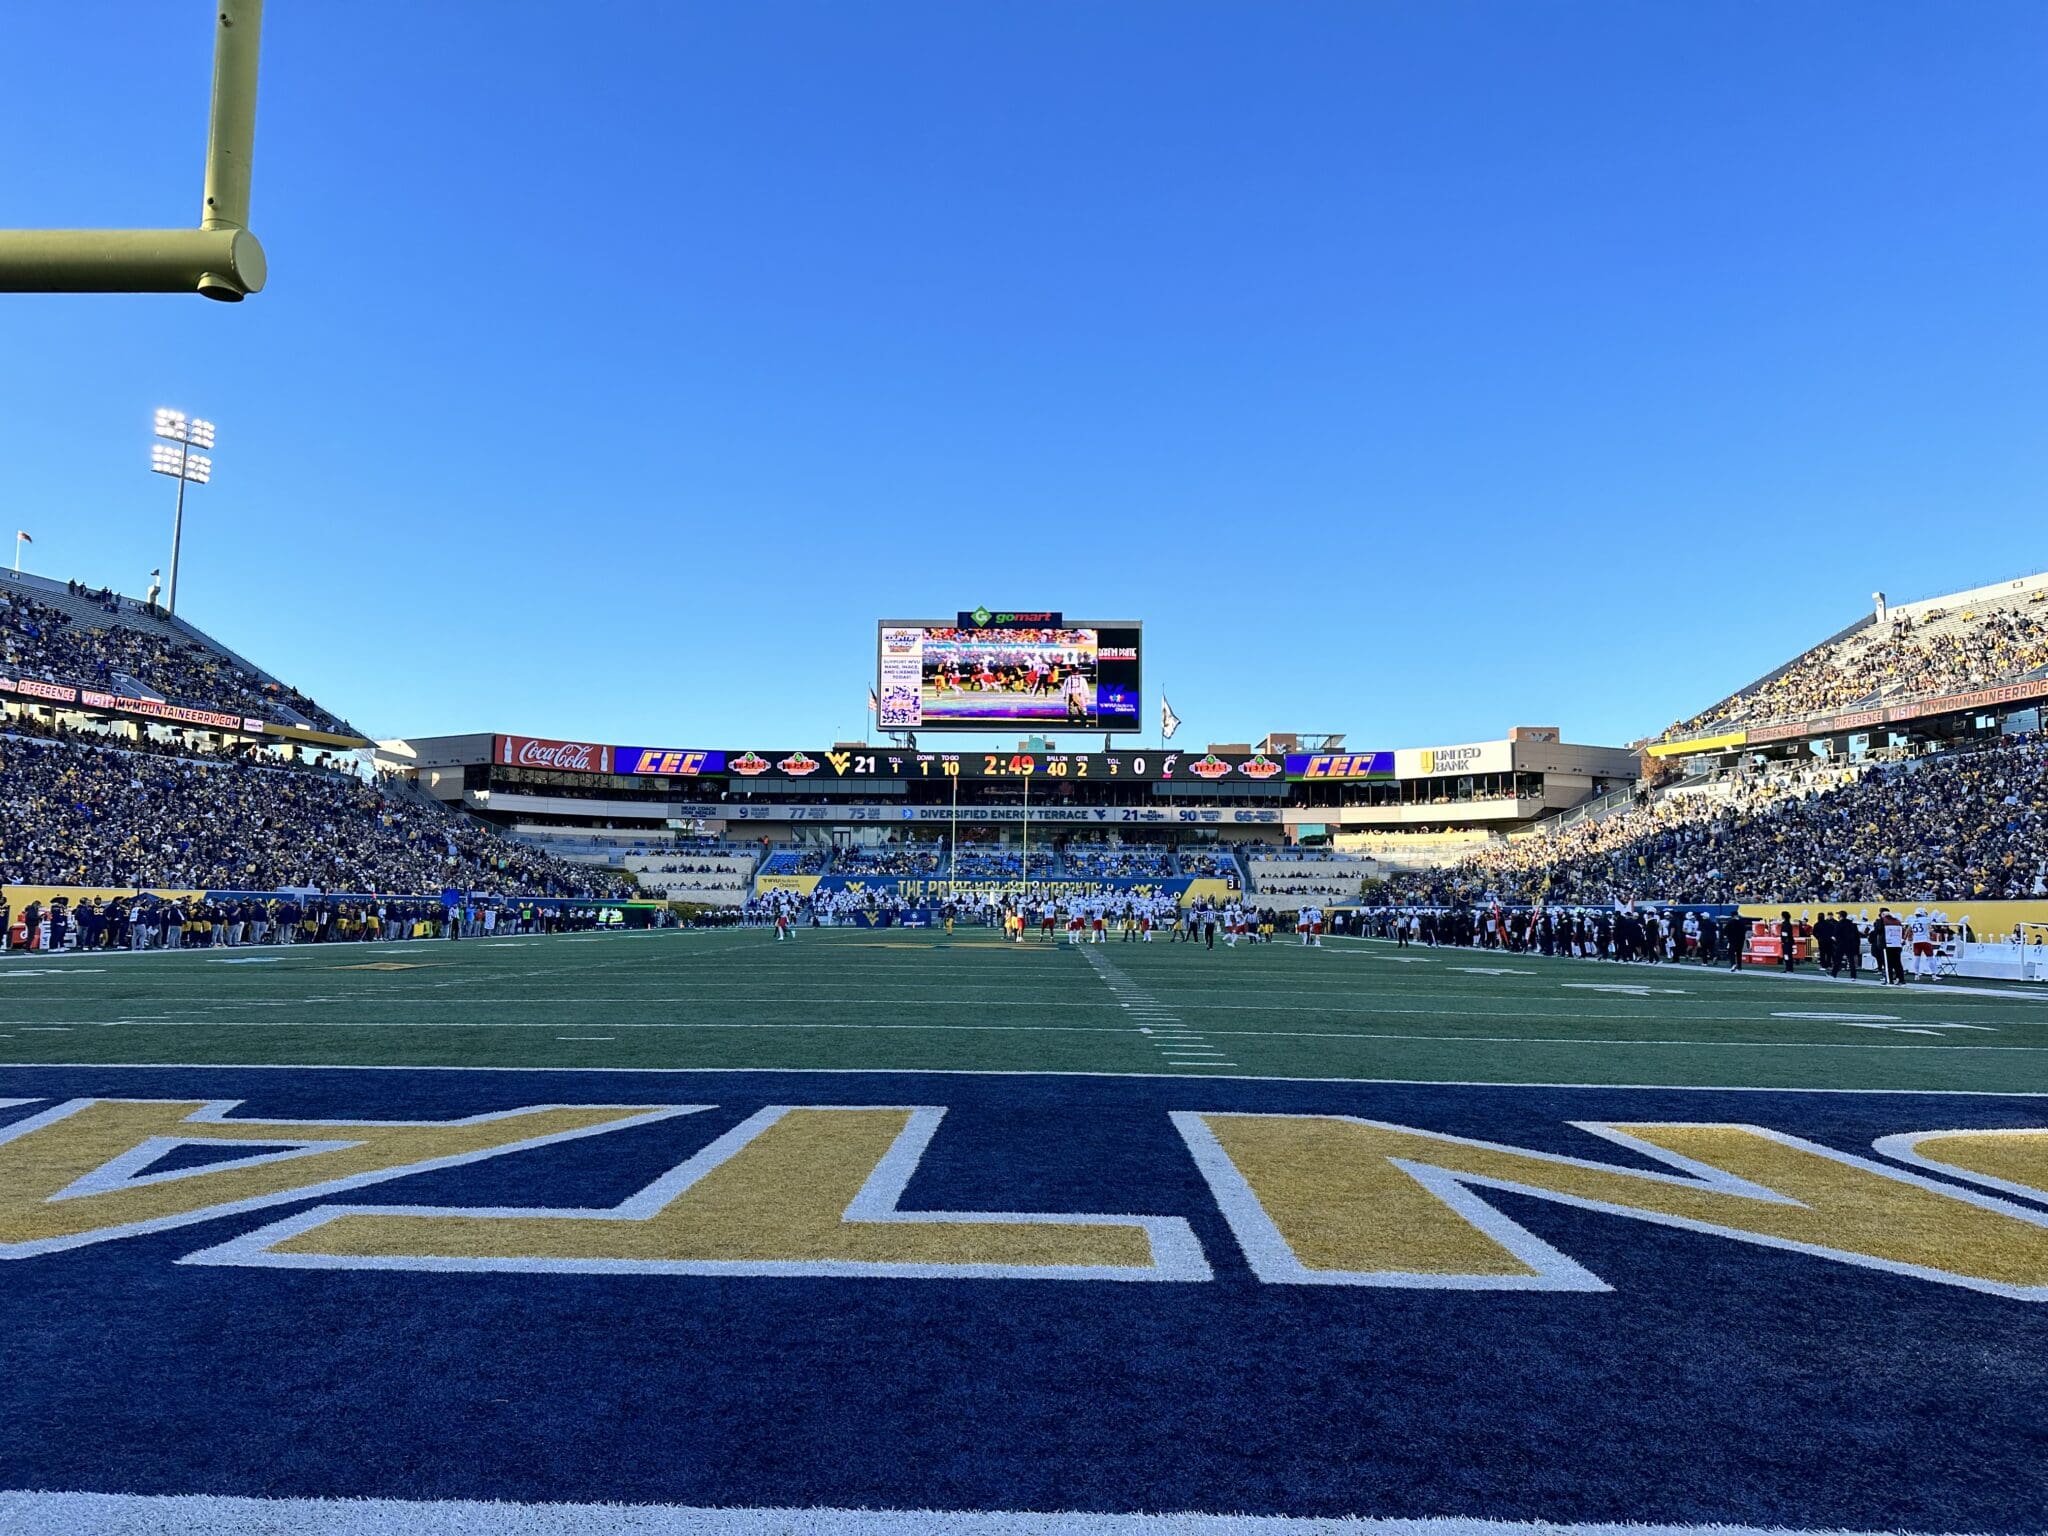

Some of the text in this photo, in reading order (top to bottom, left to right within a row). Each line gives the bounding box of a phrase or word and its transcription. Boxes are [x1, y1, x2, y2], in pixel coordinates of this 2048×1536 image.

[996, 612, 1051, 623] gomart
[19, 682, 75, 701] DIFFERENCE
[1834, 711, 1883, 729] DIFFERENCE
[518, 740, 594, 770] Coca-Cola
[916, 754, 935, 762] DOWN
[941, 754, 960, 762] TO GO
[1435, 747, 1482, 761] UNITED
[637, 751, 704, 774] CEC
[854, 755, 877, 774] 21
[891, 763, 899, 774] 1
[920, 761, 929, 775] 1
[941, 761, 960, 776] 10
[983, 754, 1035, 776] 2:49
[1046, 761, 1068, 776] 40
[1077, 761, 1088, 776] 2
[1133, 757, 1146, 775] 0
[1193, 763, 1228, 773] TEXAS
[1243, 763, 1276, 773] TEXAS
[1306, 755, 1372, 778] CEC
[1435, 759, 1470, 772] BANK
[1109, 765, 1118, 775] 3
[738, 806, 749, 819] 9
[789, 807, 807, 819] 77
[848, 807, 866, 819] 75
[920, 809, 1089, 819] DIVERSIFIED ENERGY TERRACE
[1122, 809, 1138, 821] 21
[1179, 809, 1197, 822] 90
[897, 880, 925, 897] THE
